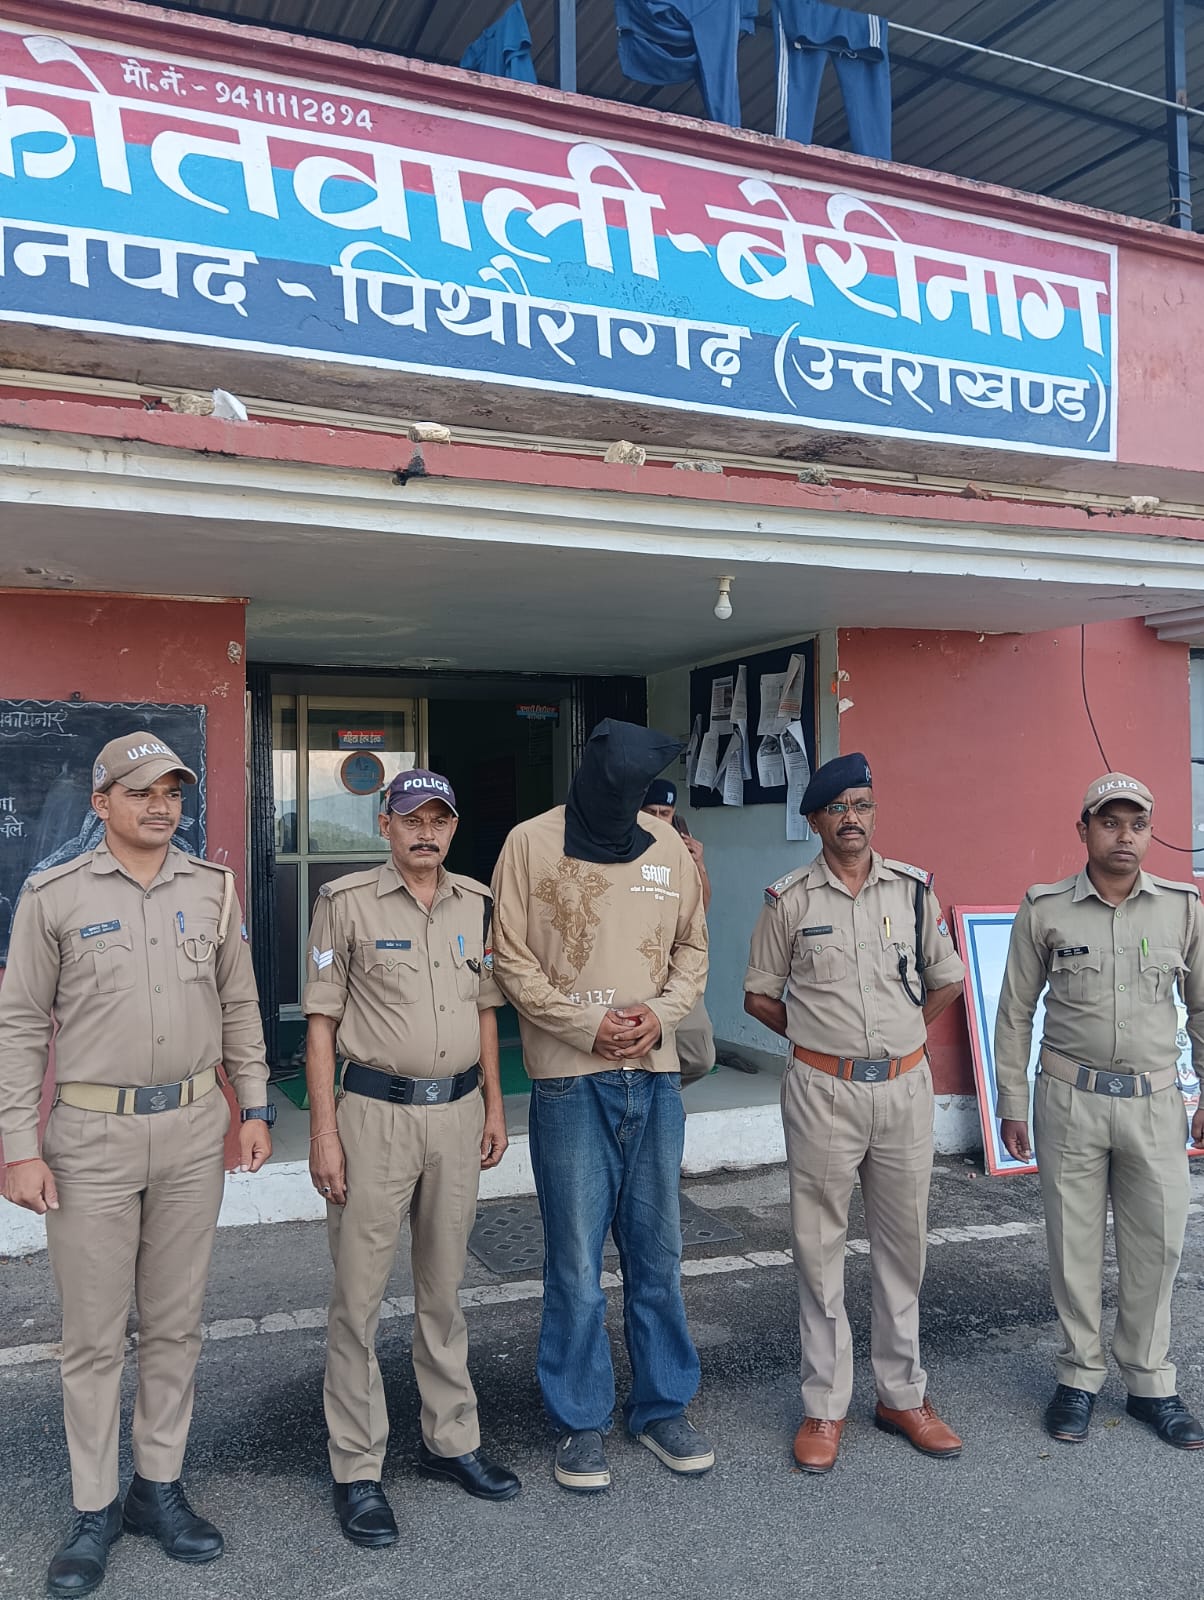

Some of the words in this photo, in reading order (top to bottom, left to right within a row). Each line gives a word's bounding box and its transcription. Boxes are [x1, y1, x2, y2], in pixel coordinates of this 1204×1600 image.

[214, 81, 375, 132] 9411112894
[0, 216, 260, 318] नपद
[330, 240, 753, 389] पिथौरागढ़
[403, 777, 450, 796] POLICE
